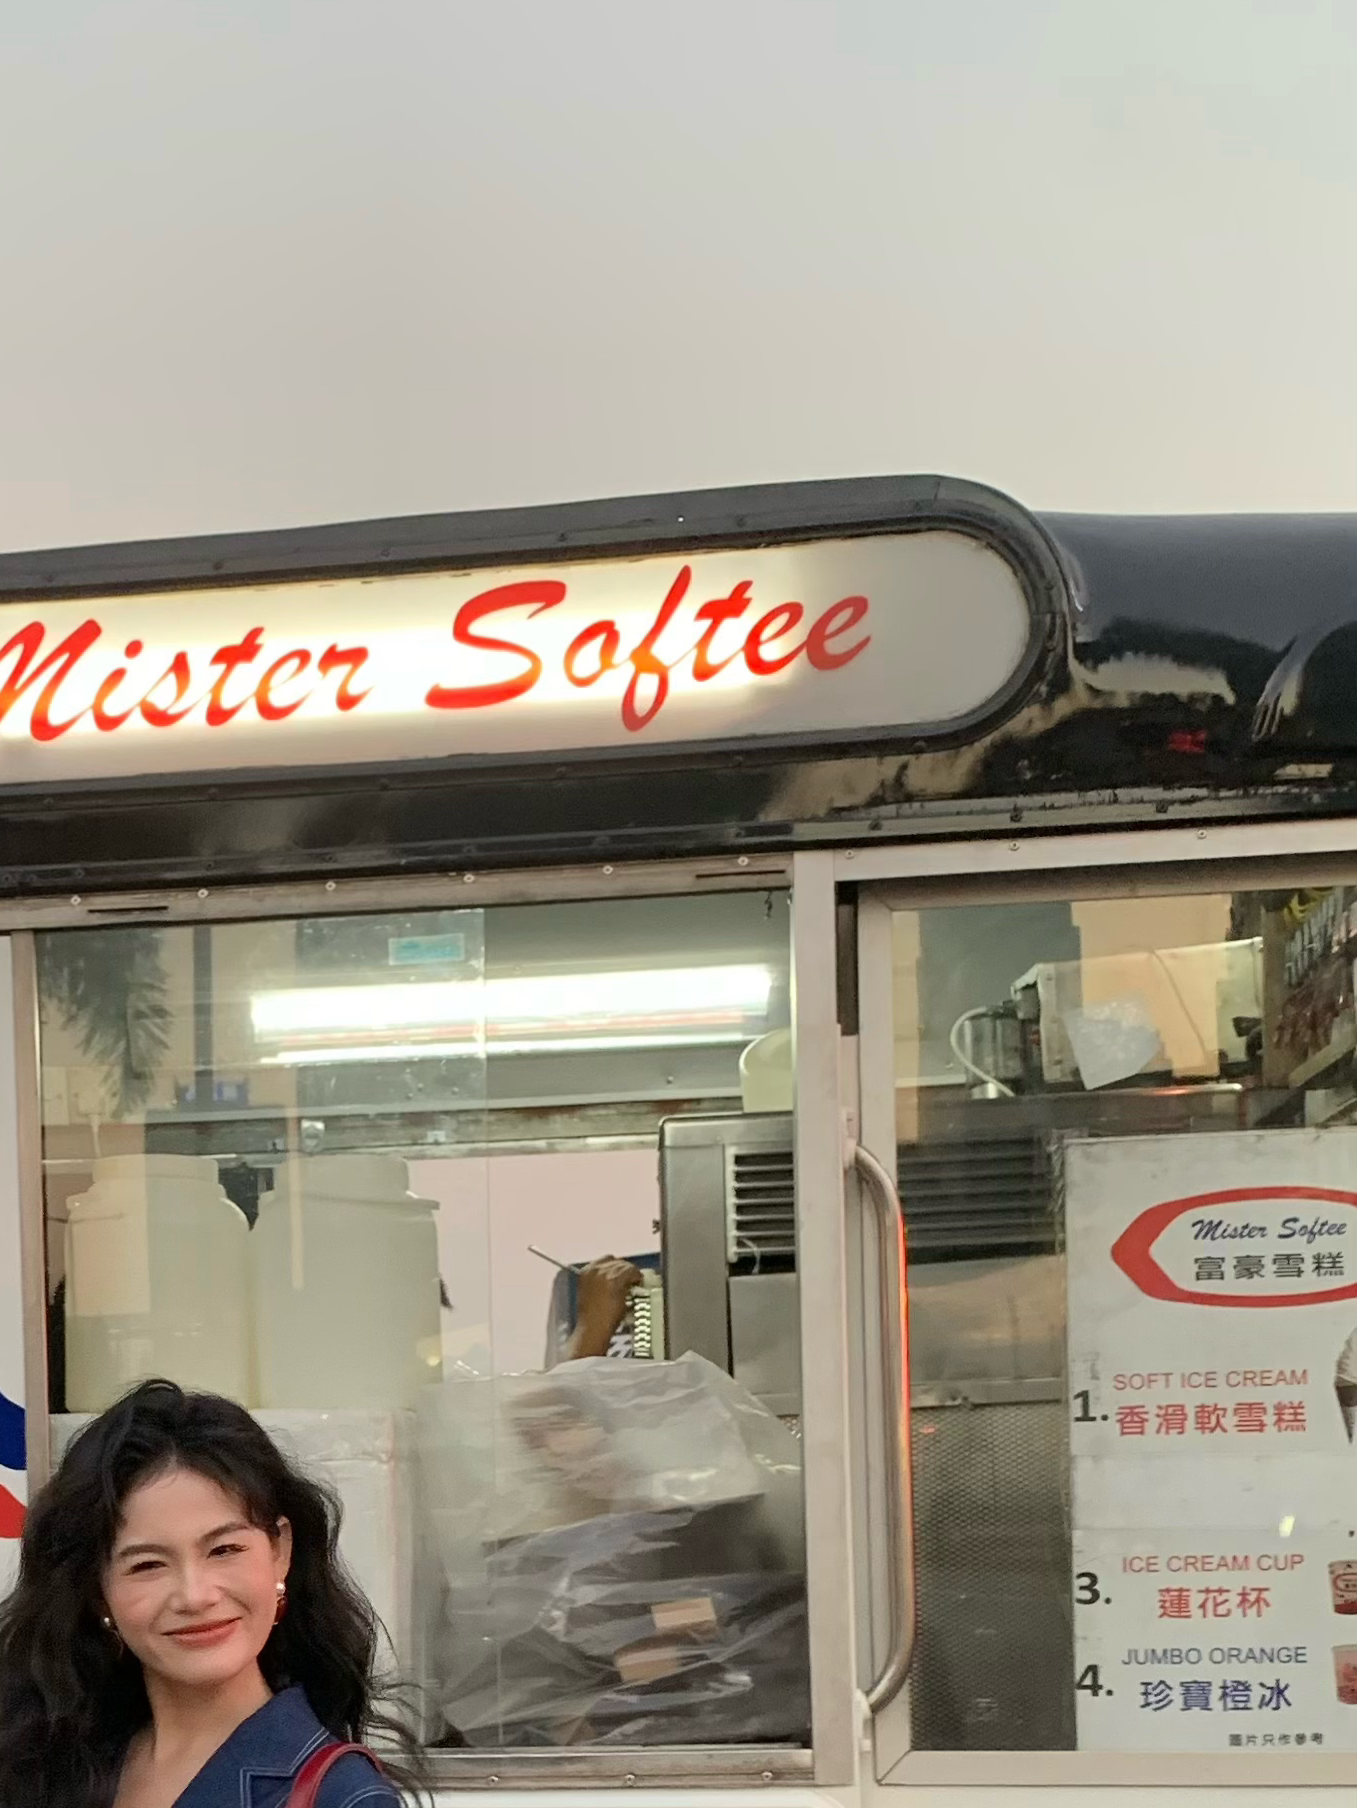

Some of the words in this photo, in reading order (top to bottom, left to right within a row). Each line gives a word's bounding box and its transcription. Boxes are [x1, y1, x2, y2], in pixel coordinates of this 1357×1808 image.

[424, 564, 872, 733] Softee
[1191, 1217, 1267, 1242] Mister
[1277, 1215, 1347, 1243] Softee
[1193, 1250, 1346, 1283] 富豪雪糕
[1112, 1372, 1174, 1392] SOFT
[1180, 1371, 1219, 1389] ICE
[1225, 1368, 1309, 1388] CREAM
[1073, 1390, 1109, 1423] 1.
[1115, 1401, 1308, 1437] 香滑軟雪糕
[1121, 1556, 1159, 1574] ICE
[1166, 1555, 1251, 1573] CREAM
[1257, 1553, 1305, 1573] CUP
[1074, 1571, 1112, 1606] 3.
[1158, 1586, 1272, 1621] 蓮花杯
[1121, 1647, 1203, 1667] JUMBO
[1209, 1645, 1309, 1665] ORANGE
[1075, 1664, 1114, 1698] 4.
[1139, 1677, 1293, 1713] 珍寶橙冰
